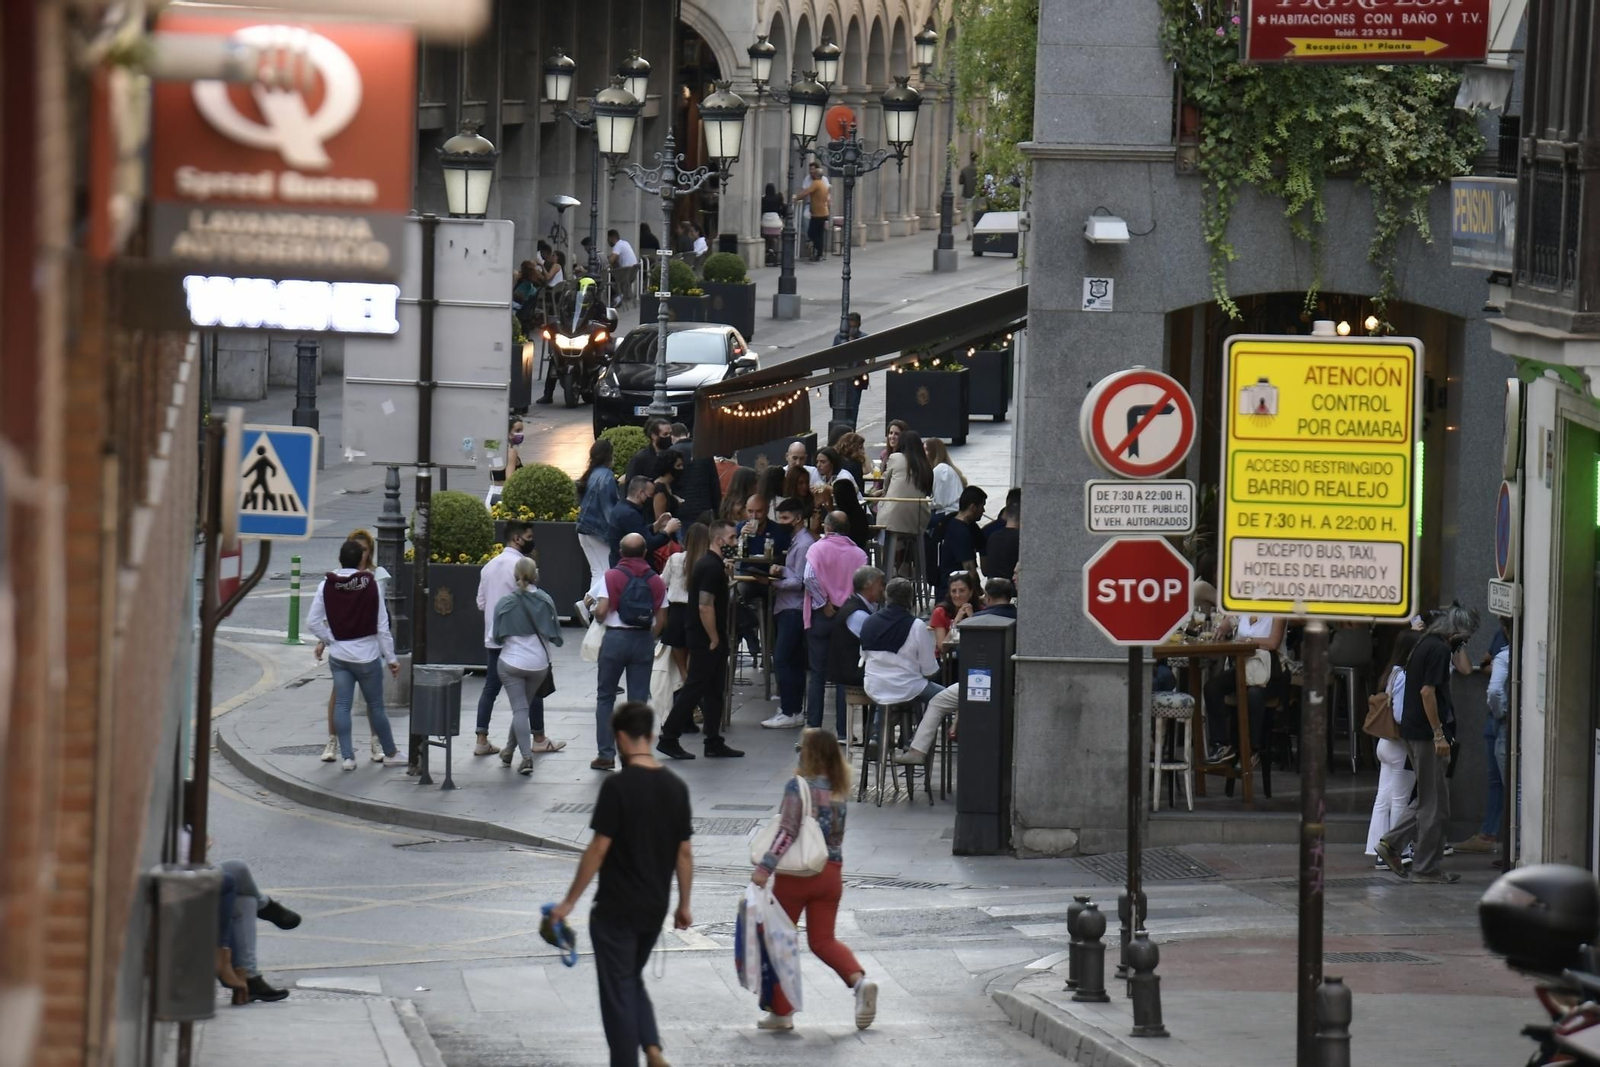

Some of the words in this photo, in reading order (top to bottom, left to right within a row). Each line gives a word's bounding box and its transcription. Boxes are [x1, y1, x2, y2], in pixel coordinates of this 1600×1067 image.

[1269, 13, 1355, 25] HABITACIONES
[1364, 13, 1393, 24] CON
[1402, 11, 1438, 24] BAÑO
[1446, 12, 1453, 24] Y
[1461, 12, 1482, 24] T.V.
[1334, 28, 1359, 37] Teléf.
[1361, 28, 1374, 36] 22
[1376, 28, 1389, 36] 93
[1391, 28, 1403, 36] 81
[1305, 43, 1358, 52] Recepción
[1378, 42, 1412, 50] Planta
[1454, 188, 1493, 234] PENSION
[1304, 362, 1402, 387] ATENCIÓN
[1311, 393, 1392, 412] CONTROL
[1297, 418, 1331, 435] POR
[1335, 419, 1403, 437] CAMARA
[1245, 458, 1300, 473] ACCESO
[1303, 460, 1394, 476] RESTRINGIDO
[1097, 490, 1110, 500] DE
[1112, 490, 1134, 500] 7:30
[1136, 490, 1143, 500] A
[1144, 490, 1173, 500] 22:00
[1175, 490, 1186, 500] H.
[1247, 478, 1310, 496] BARRIO
[1314, 480, 1389, 498] REALEJO
[1094, 504, 1131, 514] EXCEPTO
[1132, 504, 1150, 514] TTE.
[1152, 504, 1188, 514] PUBLICO
[1094, 517, 1101, 527] Y
[1104, 517, 1124, 527] VEH.
[1126, 516, 1188, 526] AUTORIZADOS
[1238, 512, 1259, 527] DE
[1264, 513, 1296, 529] 7:30
[1300, 514, 1316, 529] H.
[1320, 515, 1332, 530] A
[1335, 515, 1377, 531] 22:00
[1381, 517, 1397, 532] H.
[1257, 543, 1313, 558] EXCEPTO
[1316, 545, 1345, 561] BUS,
[1348, 546, 1376, 562] TAXI,
[1244, 562, 1299, 577] HOTELES
[1303, 564, 1326, 578] DEL
[1330, 565, 1377, 580] BARRIO
[1380, 566, 1388, 579] Y
[1097, 578, 1182, 603] STOP
[1308, 584, 1397, 600] AUTORIZADOS
